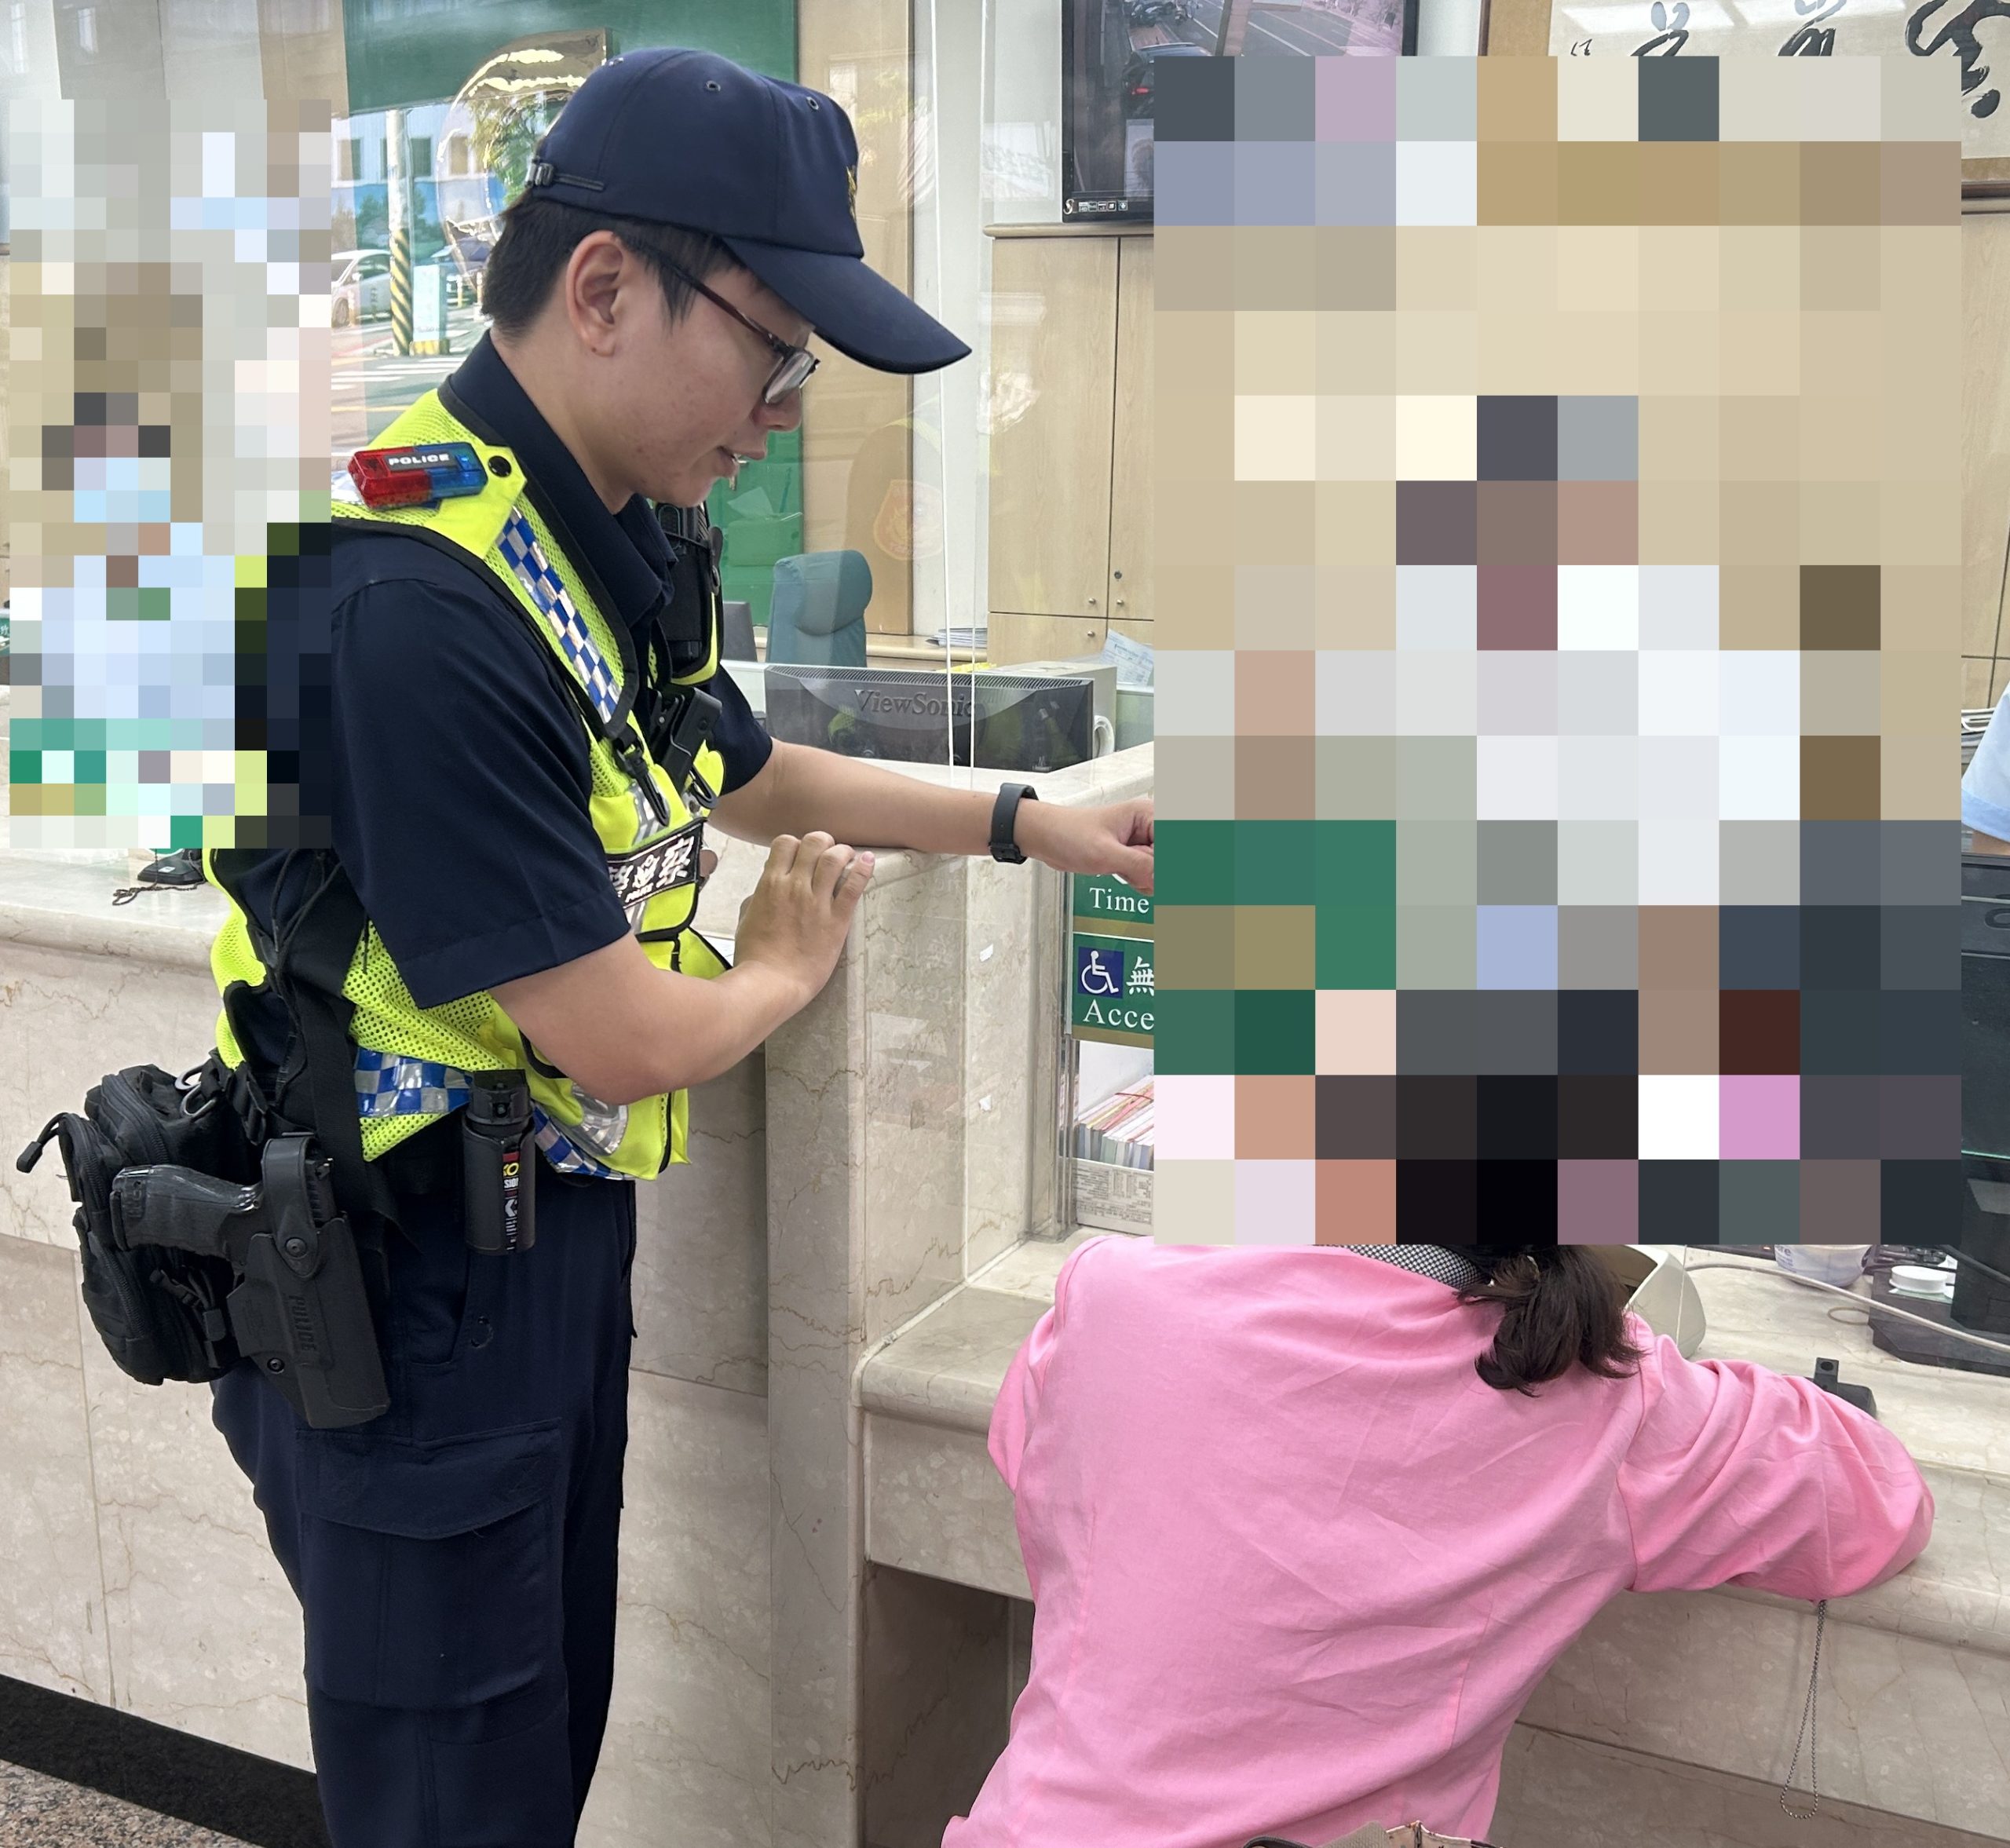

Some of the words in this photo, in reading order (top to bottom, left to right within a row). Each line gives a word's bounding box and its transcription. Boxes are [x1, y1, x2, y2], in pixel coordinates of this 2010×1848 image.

[389, 454, 449, 466] POLICE
[1089, 887, 1149, 914] Time
[1126, 955, 1154, 996] 無
